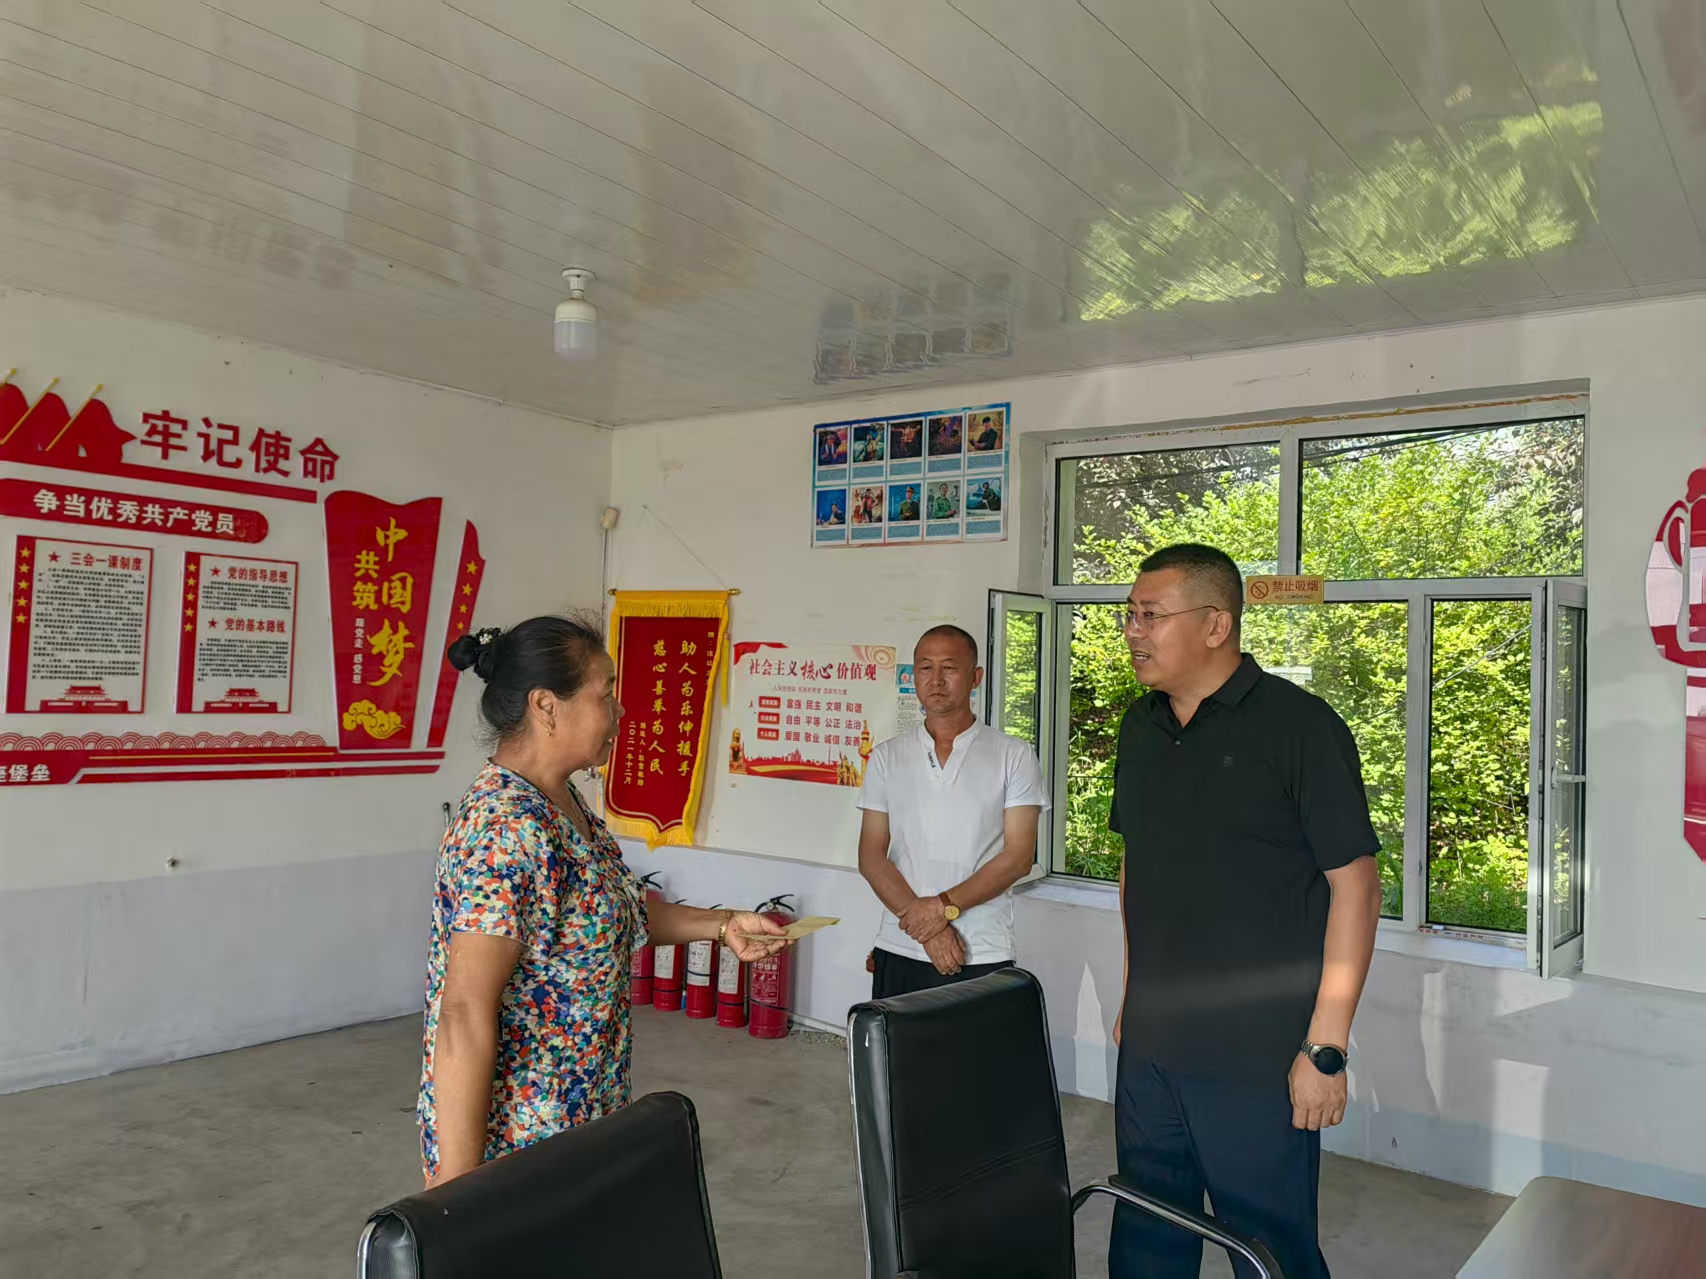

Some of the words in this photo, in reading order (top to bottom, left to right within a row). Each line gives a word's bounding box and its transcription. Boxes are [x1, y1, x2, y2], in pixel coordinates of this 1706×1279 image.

[139, 410, 340, 483] 牢记使命
[33, 488, 236, 536] 争当优秀共产党员
[70, 552, 143, 571] 三会一课制度
[228, 566, 289, 584] 党的指导思想
[352, 550, 380, 610] 共筑
[1272, 580, 1319, 592] 禁止吸烟
[366, 516, 415, 687] 中国梦
[225, 618, 287, 634] 党的基本路线
[749, 658, 877, 681] 社会主义核心价值观
[648, 639, 668, 776] 慈心善举为人民
[676, 640, 697, 777] 助人为乐伸援手
[786, 698, 802, 710] 富强
[806, 700, 821, 711] 民主
[826, 701, 842, 713] 文明
[846, 702, 862, 714] 和谐
[785, 715, 800, 726] 自由
[805, 716, 820, 728] 平等
[825, 717, 840, 729] 公正
[845, 719, 861, 731] 法治
[785, 730, 800, 742] 爱国
[804, 732, 820, 744] 敬业
[824, 733, 840, 746] 诚信
[844, 735, 860, 748] 友善
